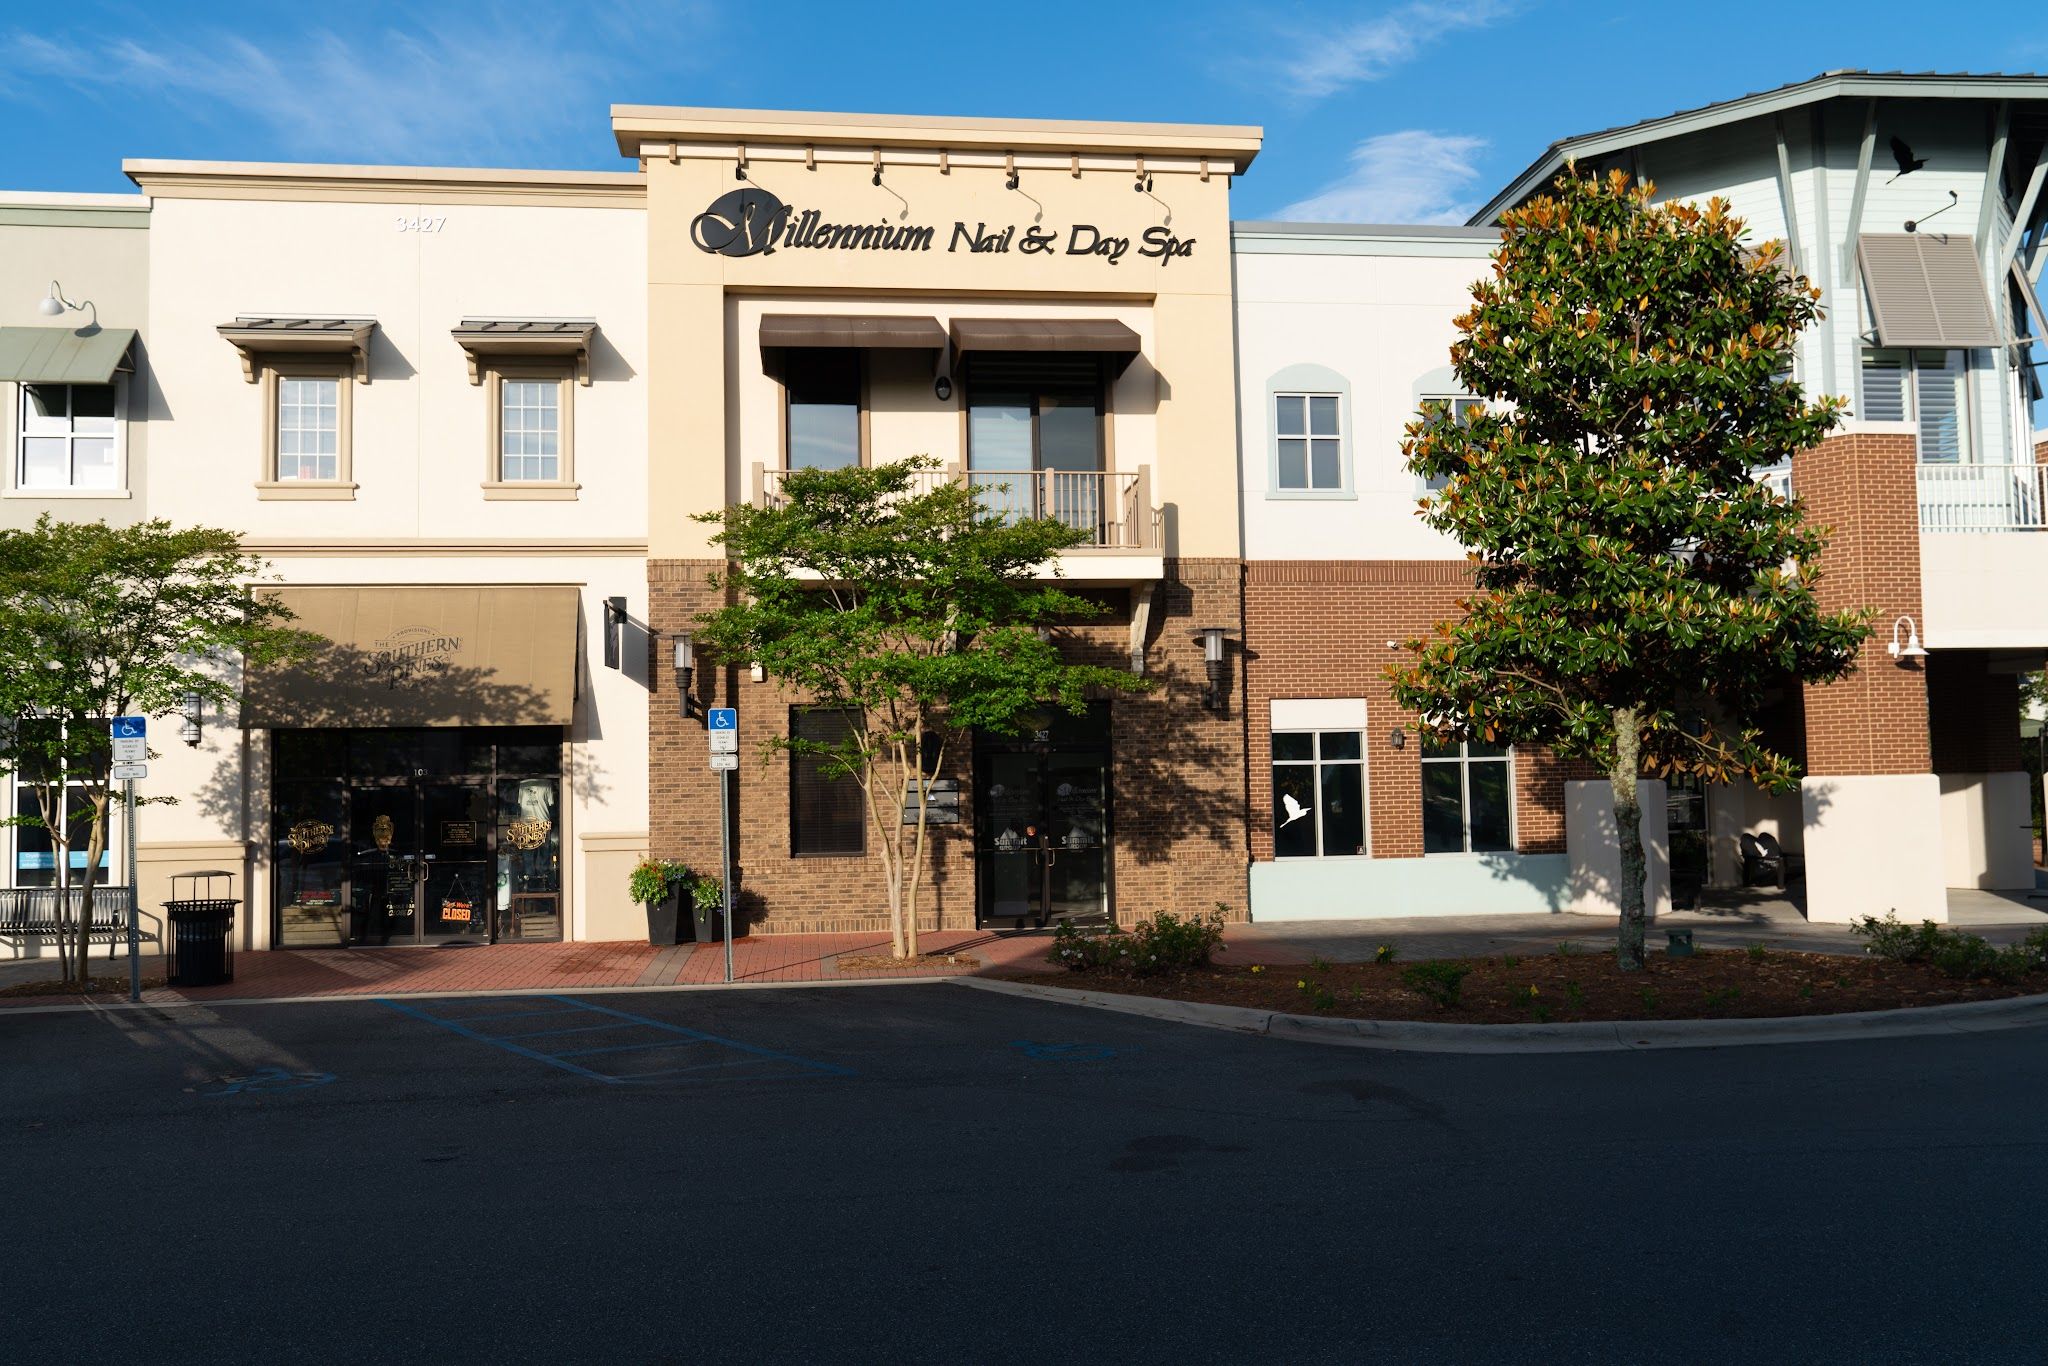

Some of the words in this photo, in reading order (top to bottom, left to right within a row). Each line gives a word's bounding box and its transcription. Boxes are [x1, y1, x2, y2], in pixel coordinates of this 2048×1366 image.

[395, 216, 447, 233] 3427
[689, 201, 936, 256] Millennium
[948, 221, 1016, 253] Nail
[1018, 225, 1058, 255] &
[1066, 224, 1130, 266] Day
[1137, 226, 1197, 267] Spa
[396, 627, 432, 637] PROVISIONS
[364, 637, 459, 677] SOUTHERN
[387, 654, 442, 690] PINES
[1034, 730, 1049, 739] 3427
[414, 768, 428, 777] 103
[287, 825, 332, 848] SOUTHERN
[506, 821, 550, 842] SOUTHERN
[993, 836, 1027, 846] Summit
[1061, 836, 1095, 845] Summit
[442, 907, 471, 920] CLOSED
